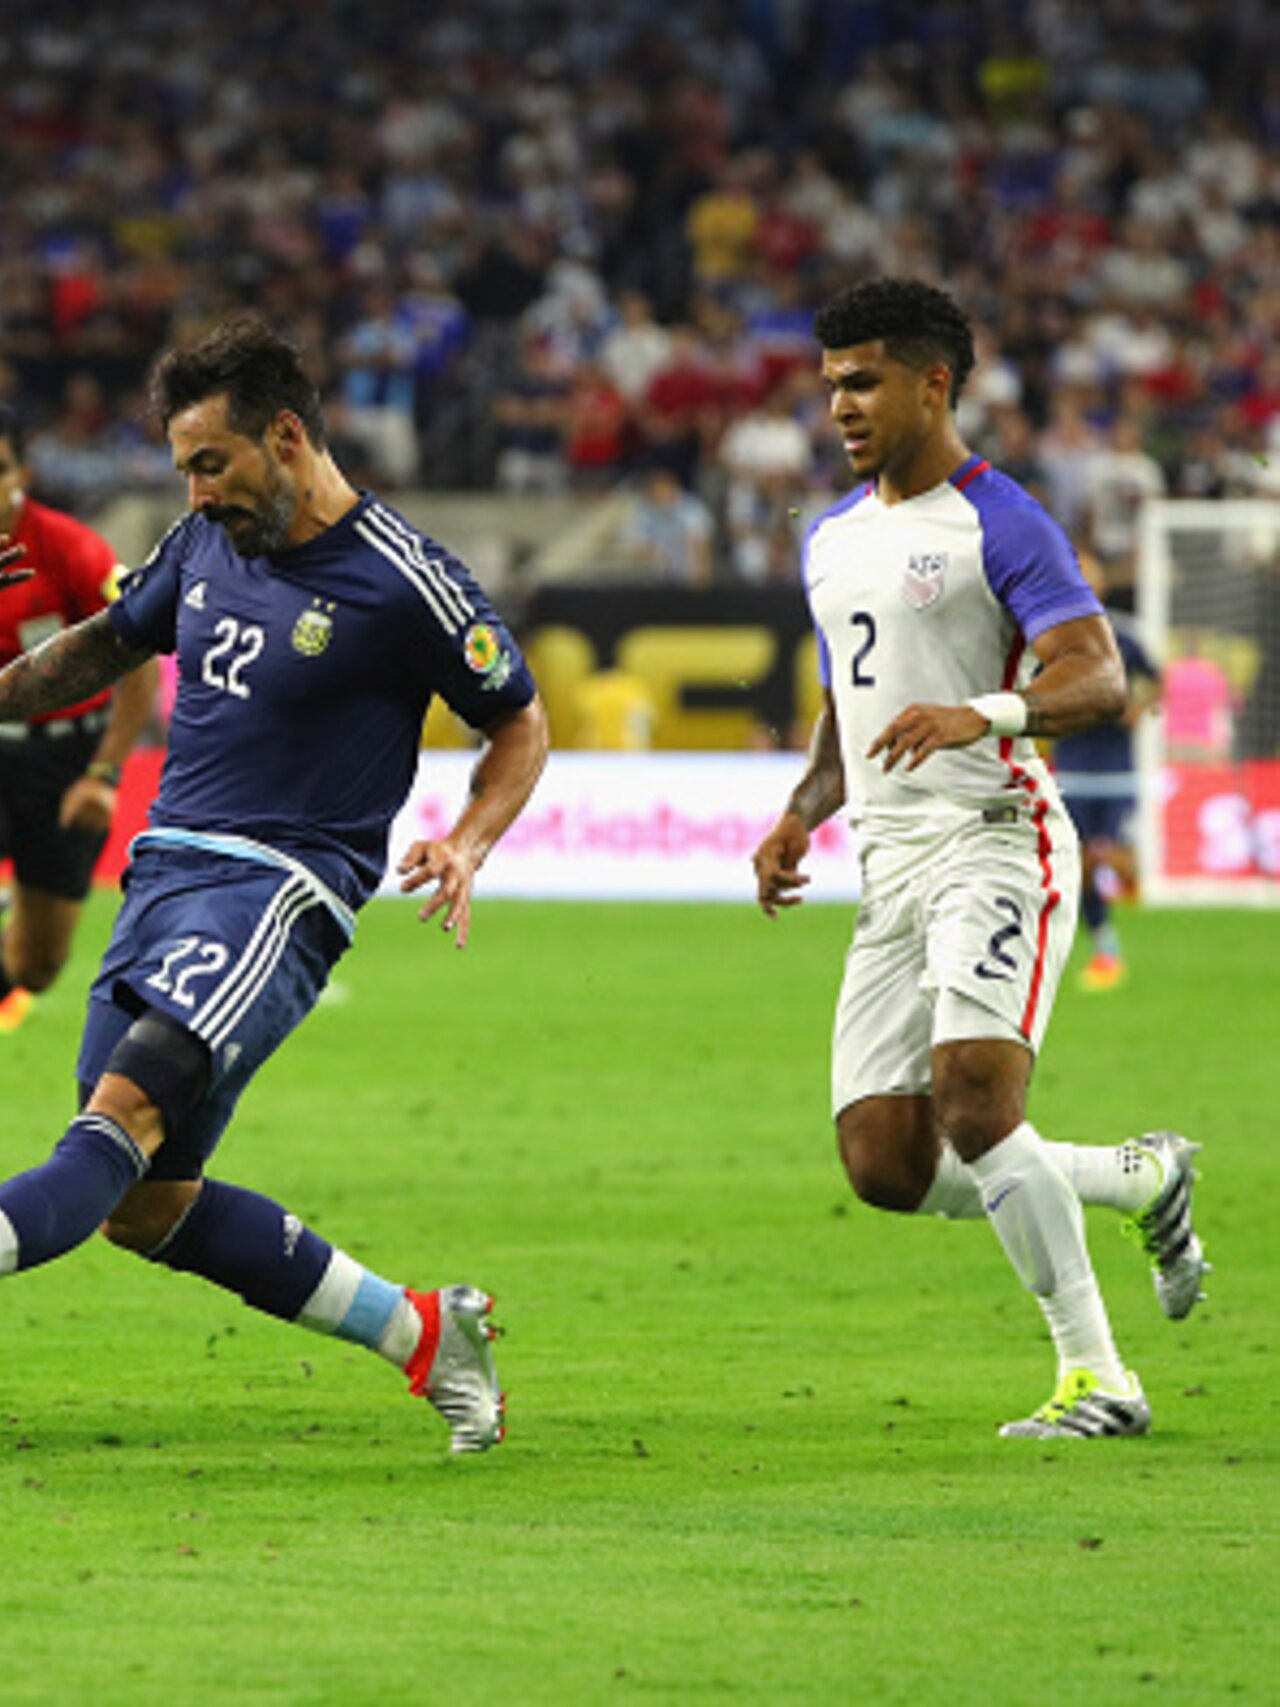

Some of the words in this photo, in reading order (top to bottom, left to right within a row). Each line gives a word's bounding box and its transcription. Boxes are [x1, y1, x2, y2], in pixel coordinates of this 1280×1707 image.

[201, 616, 265, 699] 22
[849, 611, 877, 687] 2
[989, 896, 1022, 971] 2
[145, 935, 229, 1010] 22
